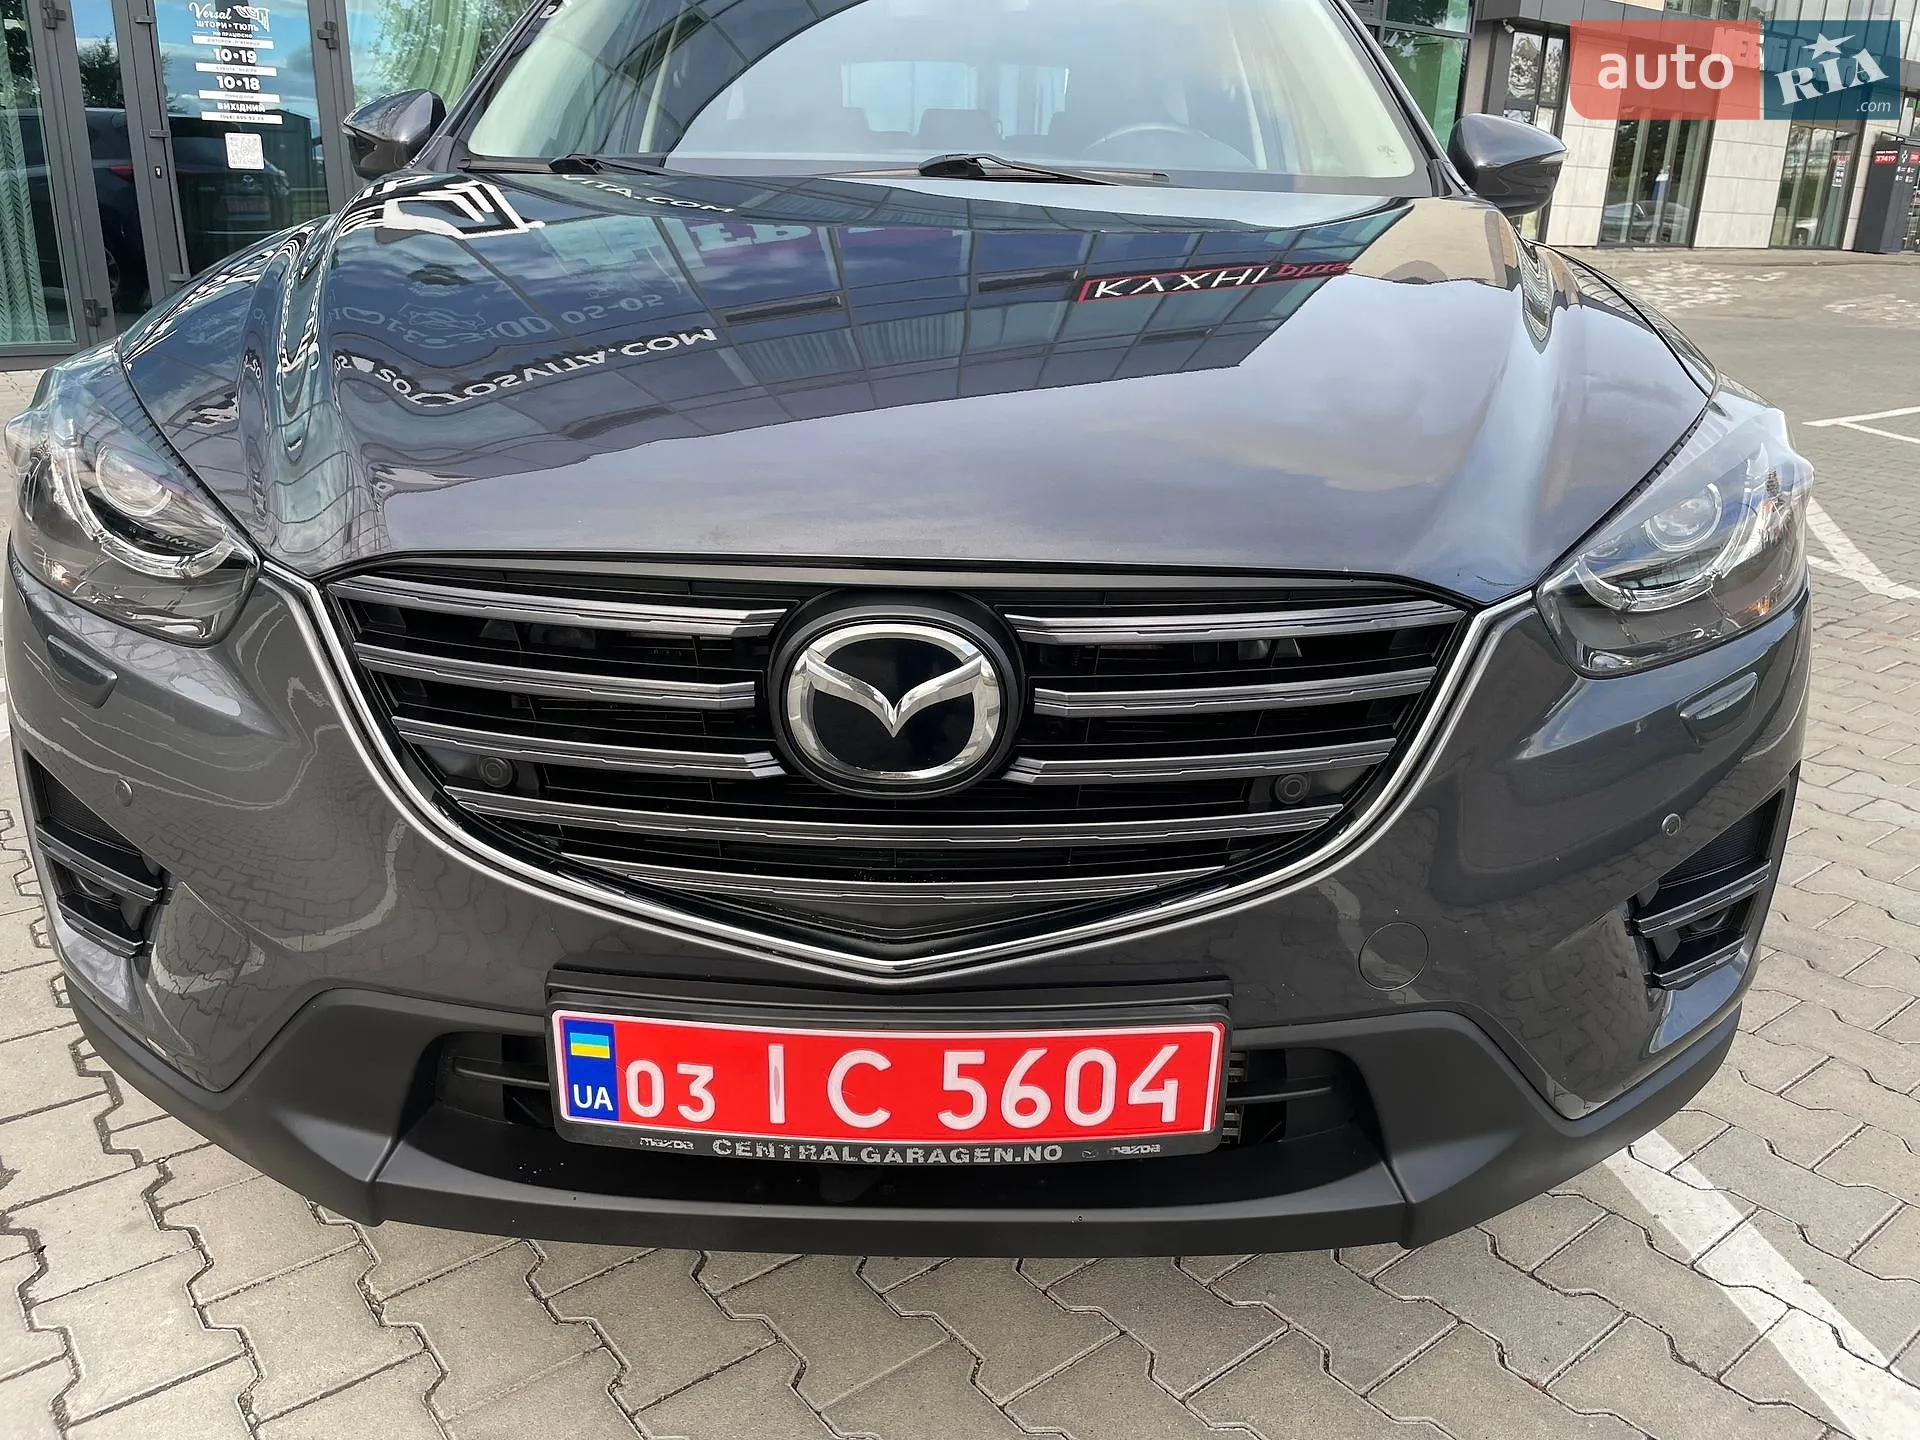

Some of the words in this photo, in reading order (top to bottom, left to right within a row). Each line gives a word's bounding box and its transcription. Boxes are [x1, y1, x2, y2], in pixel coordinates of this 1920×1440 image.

[189, 2, 232, 20] Versal
[574, 1084, 613, 1113] UA
[626, 1060, 716, 1123] 03
[938, 1044, 1180, 1132] 5604
[713, 1138, 1064, 1165] CENTRALGARAGEN.NO
